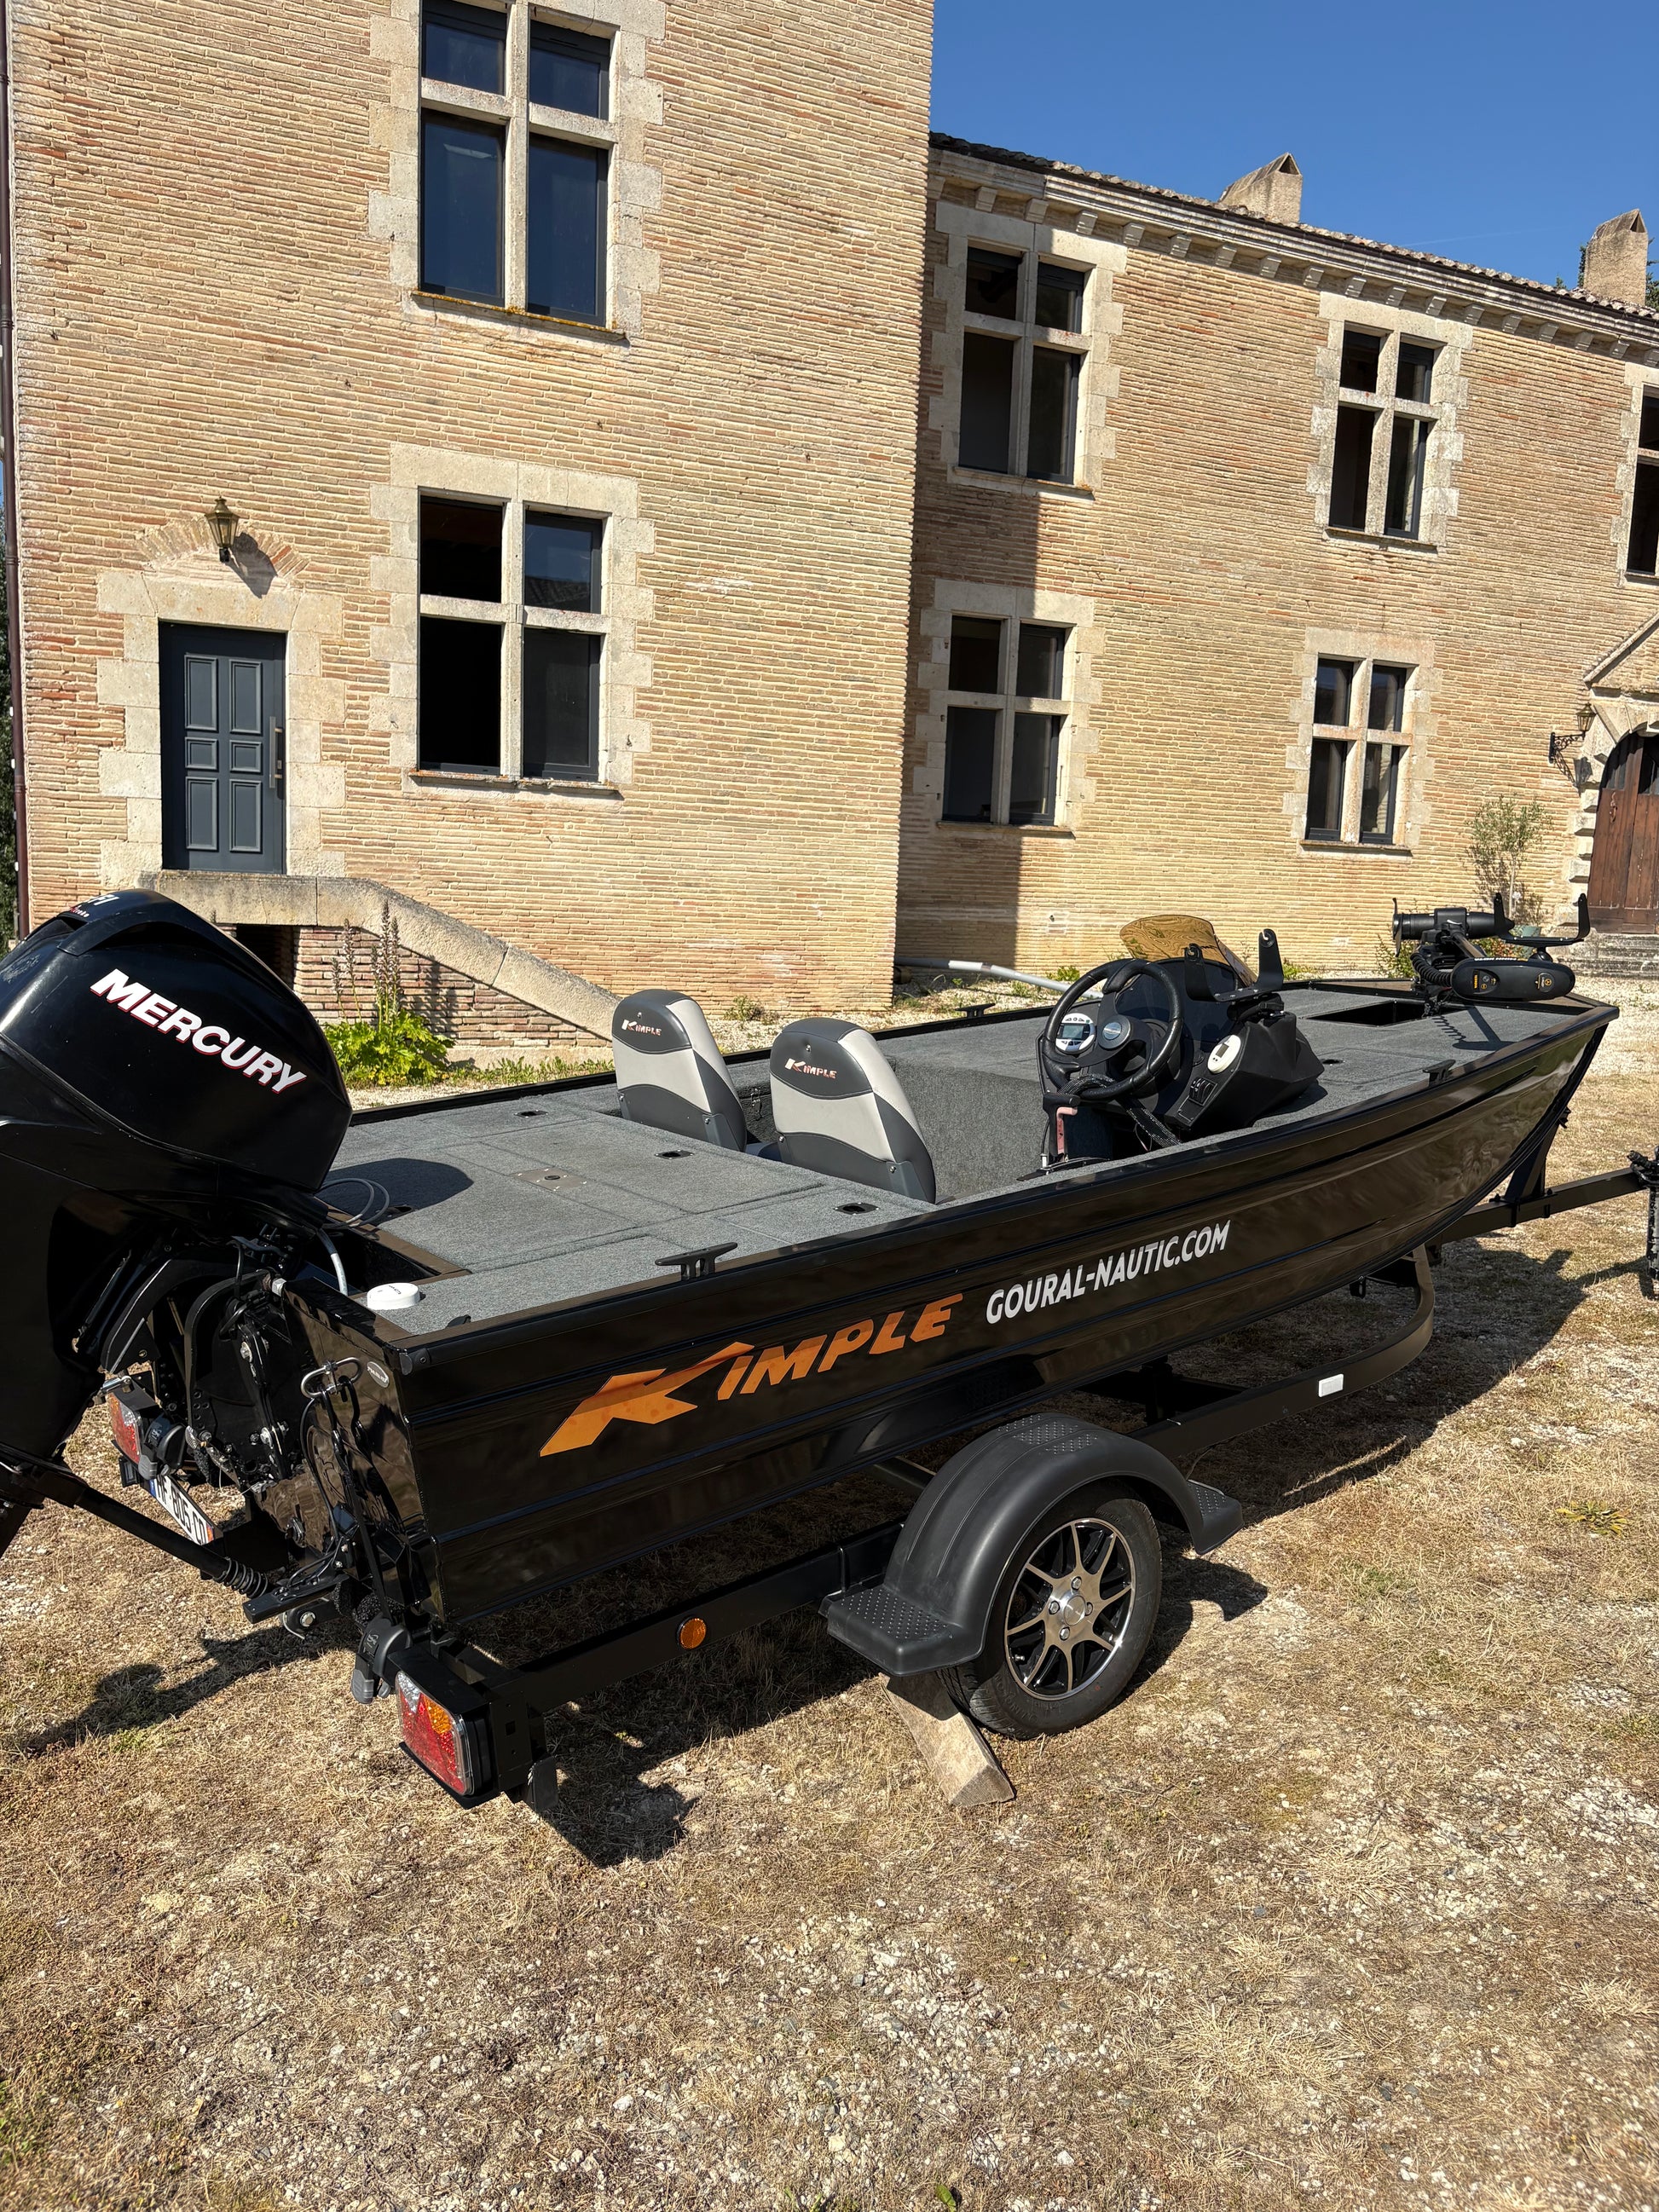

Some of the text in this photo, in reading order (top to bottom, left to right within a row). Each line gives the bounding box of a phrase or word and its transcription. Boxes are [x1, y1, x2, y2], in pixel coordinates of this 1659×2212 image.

[90, 968, 308, 1094] MERCURY
[621, 1019, 662, 1037] KIMPLE
[784, 1058, 837, 1079] KIMPLE
[985, 1219, 1230, 1325] GOURAL-NAUTIC.COM
[540, 1292, 963, 1457] KIMPLE
